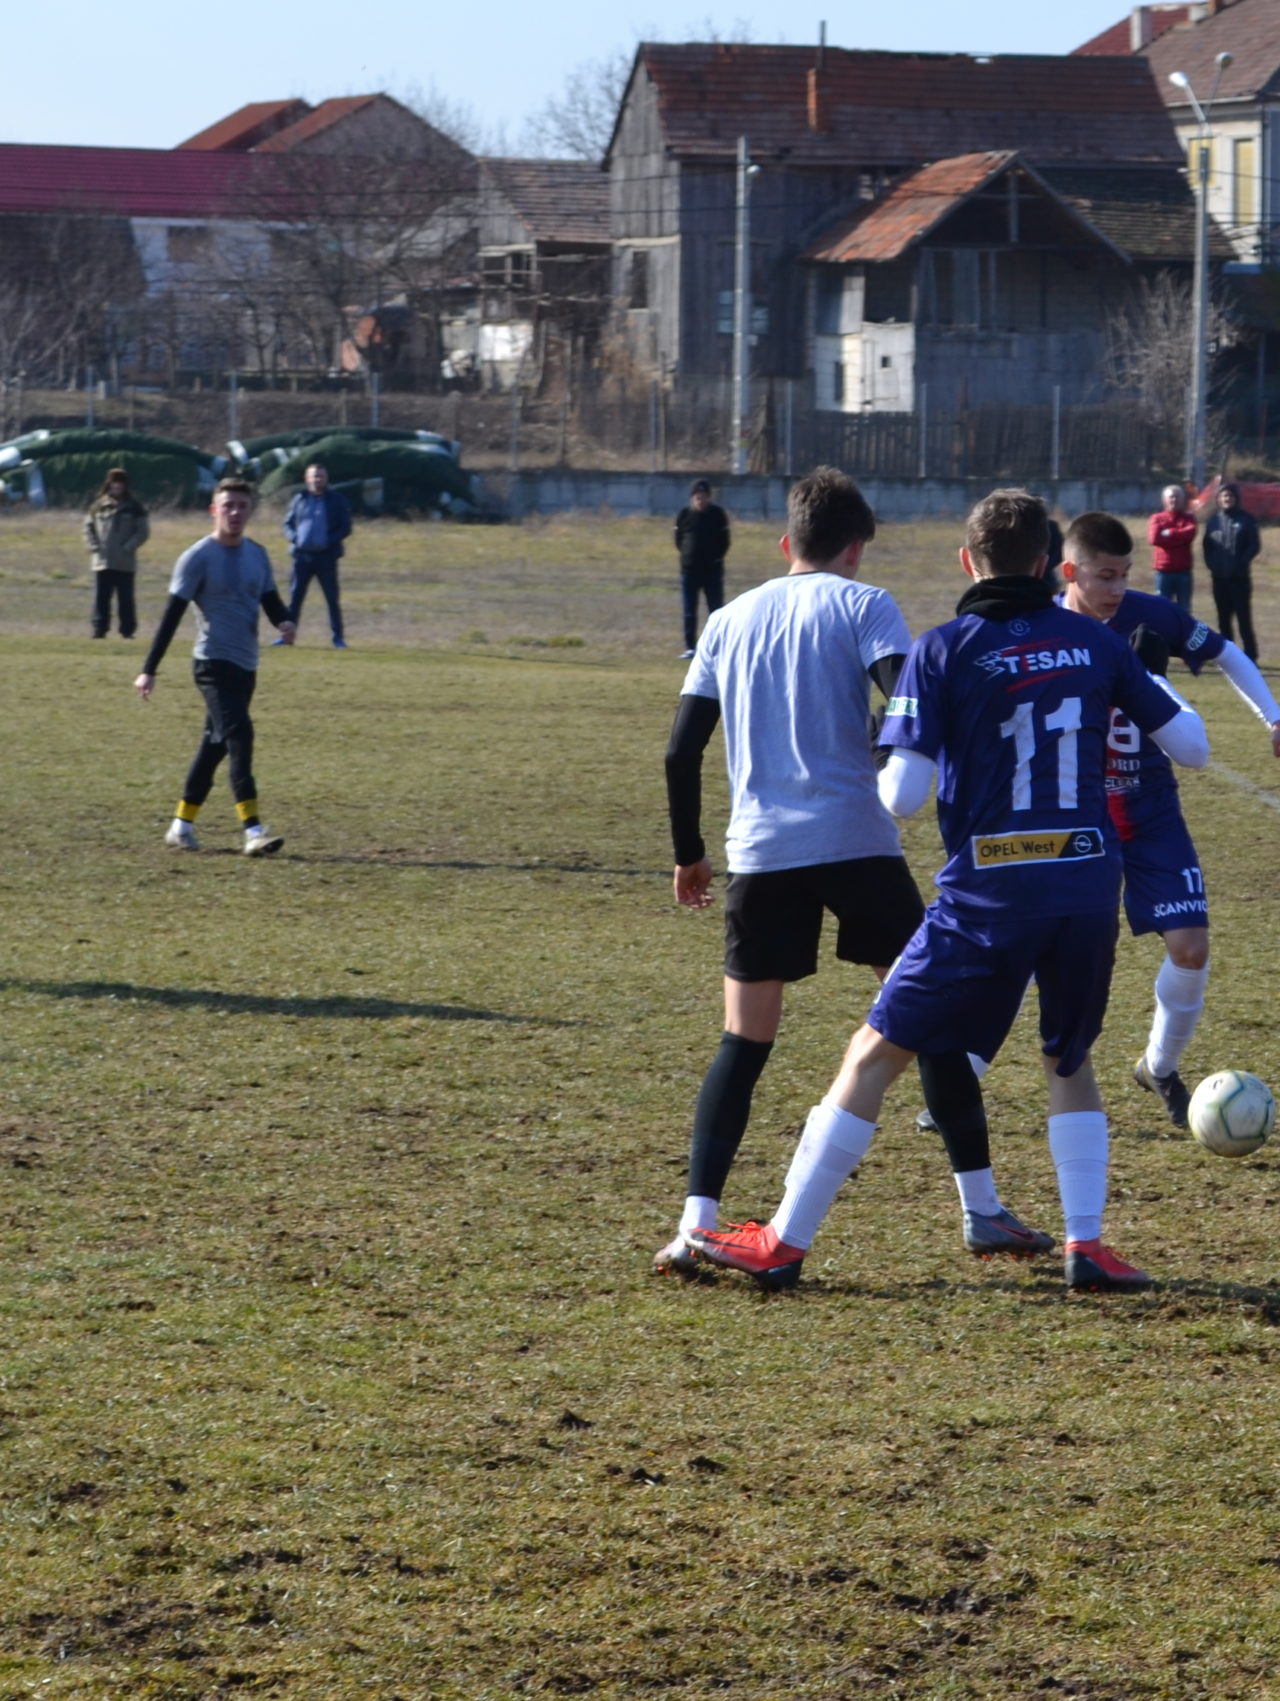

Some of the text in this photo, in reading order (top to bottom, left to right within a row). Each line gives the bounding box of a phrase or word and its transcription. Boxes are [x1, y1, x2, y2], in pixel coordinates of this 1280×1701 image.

[1000, 697, 1082, 811] 11
[980, 841, 1055, 857] OPEL West
[1180, 867, 1203, 893] 17
